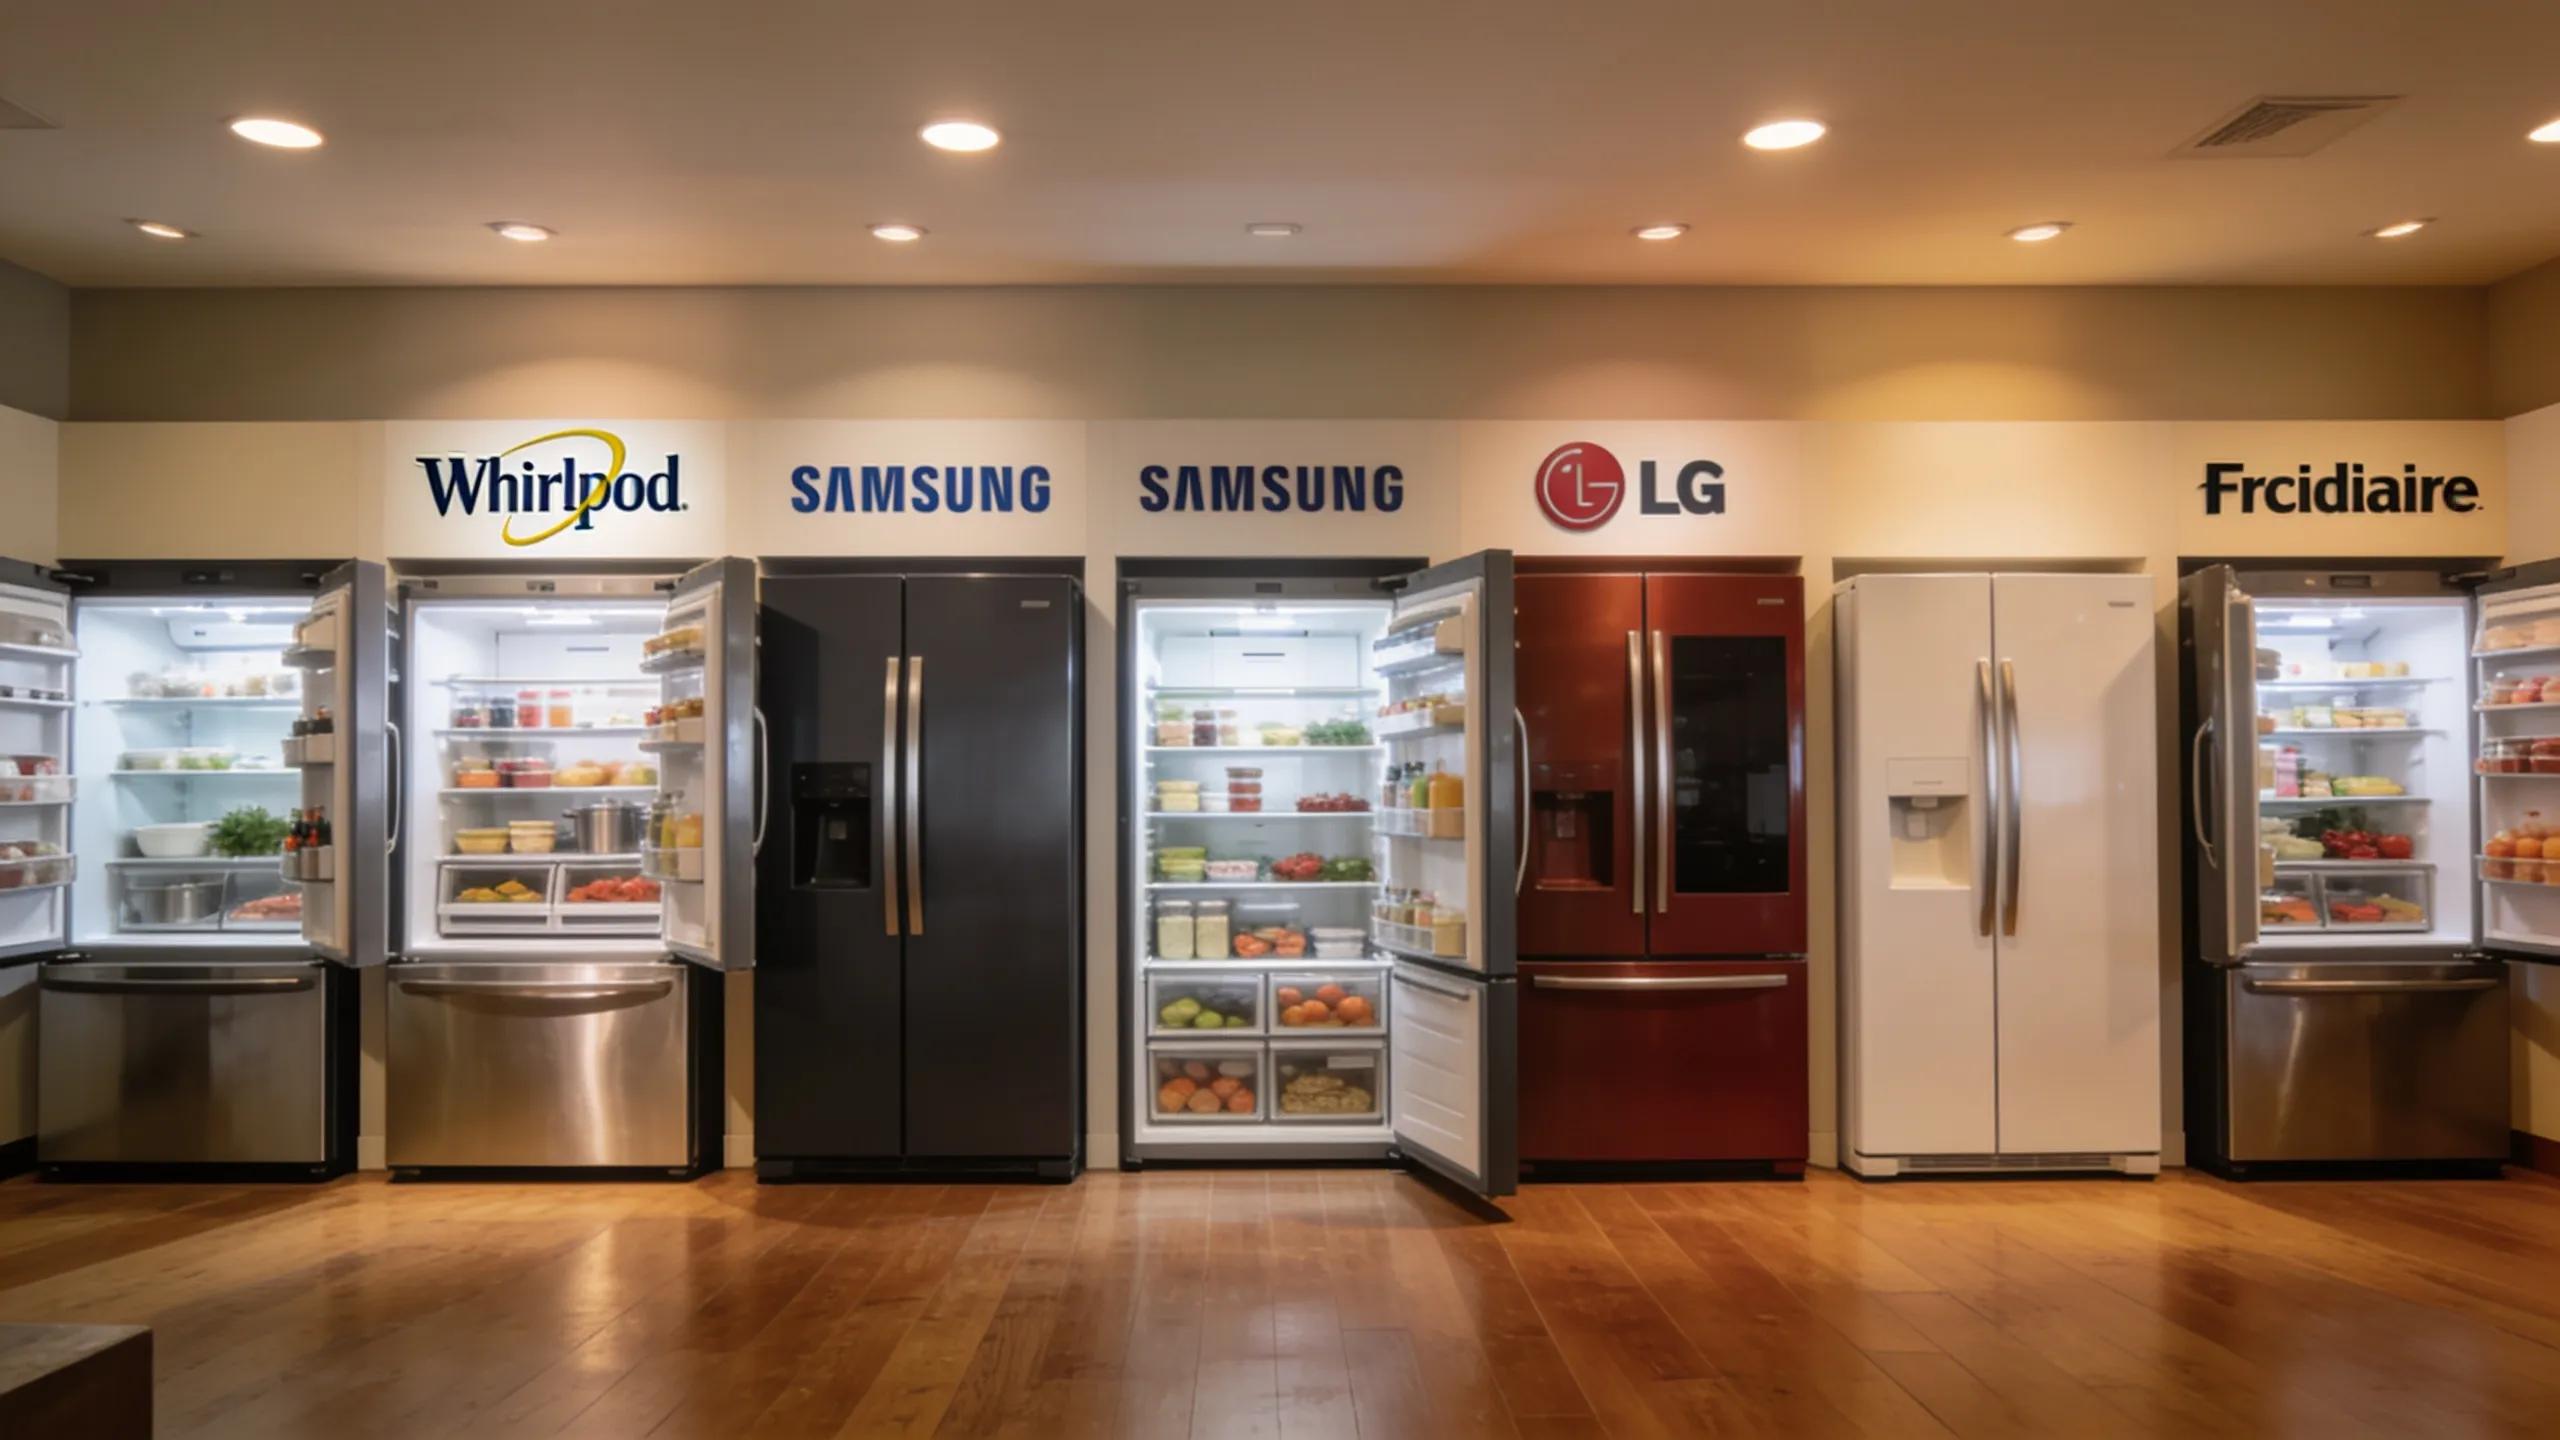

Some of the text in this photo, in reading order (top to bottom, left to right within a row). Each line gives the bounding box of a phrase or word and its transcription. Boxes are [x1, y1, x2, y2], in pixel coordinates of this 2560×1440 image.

[790, 465, 1051, 514] SAMSUNG
[1139, 464, 1404, 513] SAMSUNG
[1640, 460, 1726, 515] LG
